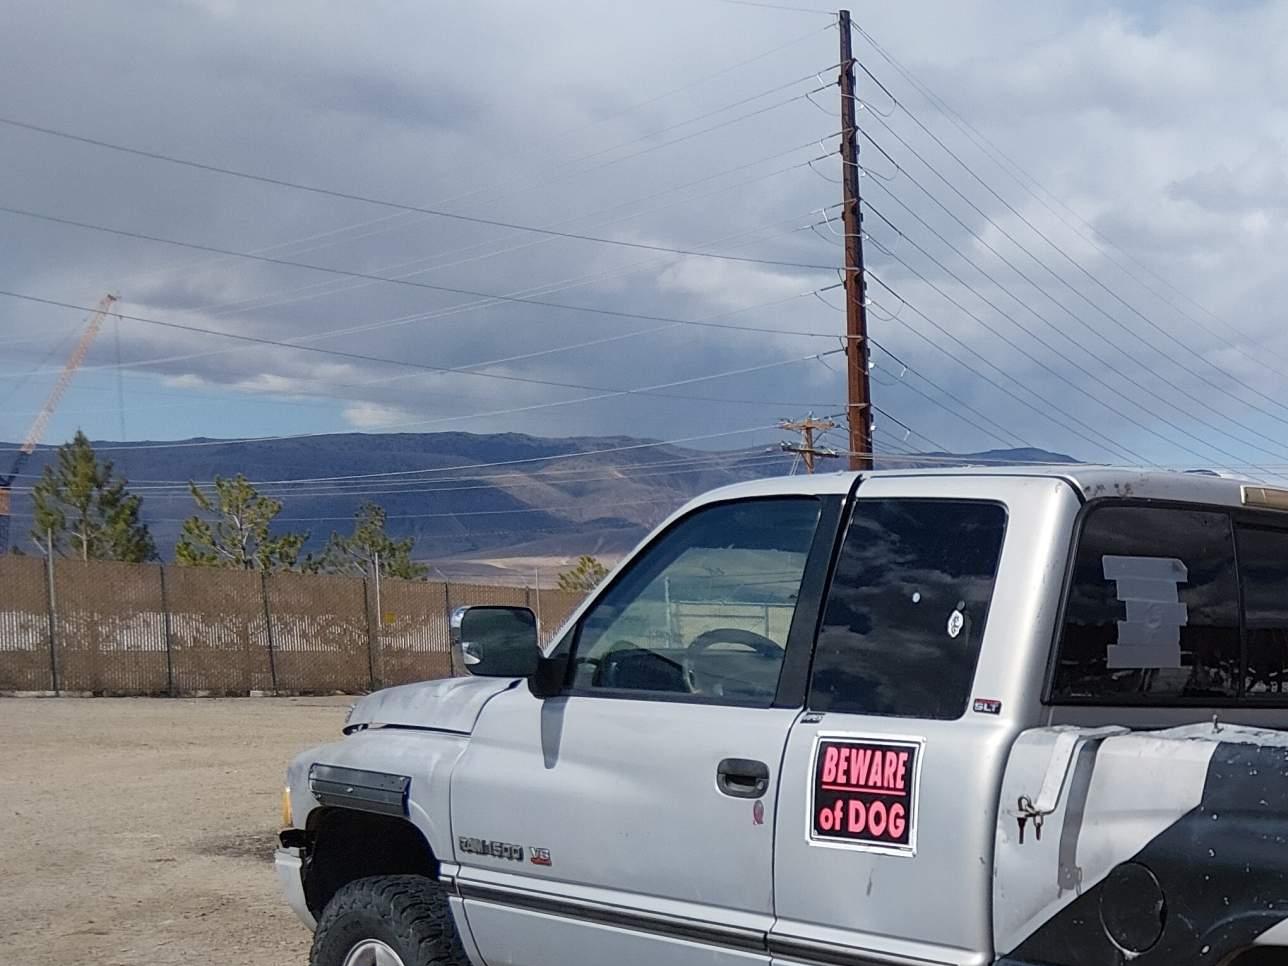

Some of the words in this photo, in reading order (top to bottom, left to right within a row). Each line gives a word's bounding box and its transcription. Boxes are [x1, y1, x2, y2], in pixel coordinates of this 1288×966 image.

[974, 702, 999, 713] SLT
[822, 746, 909, 789] BEWARE
[819, 800, 844, 831] of
[847, 800, 906, 838] DOG
